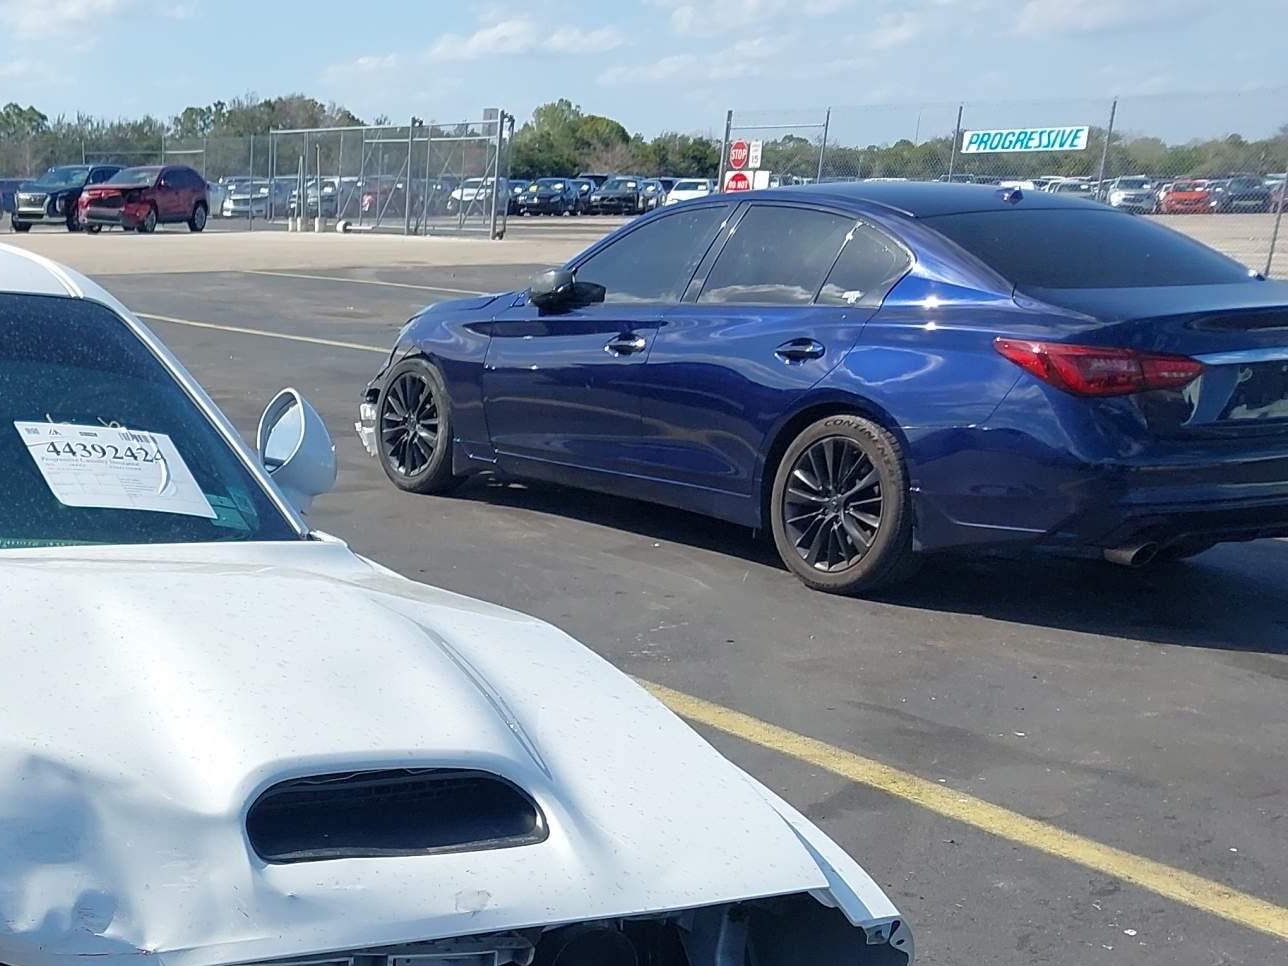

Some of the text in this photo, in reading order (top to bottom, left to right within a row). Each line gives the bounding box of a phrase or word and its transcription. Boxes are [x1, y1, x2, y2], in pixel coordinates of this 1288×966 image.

[966, 129, 1084, 151] PROGRESSIVE
[731, 148, 747, 160] STOP
[46, 441, 166, 464] 44392424
